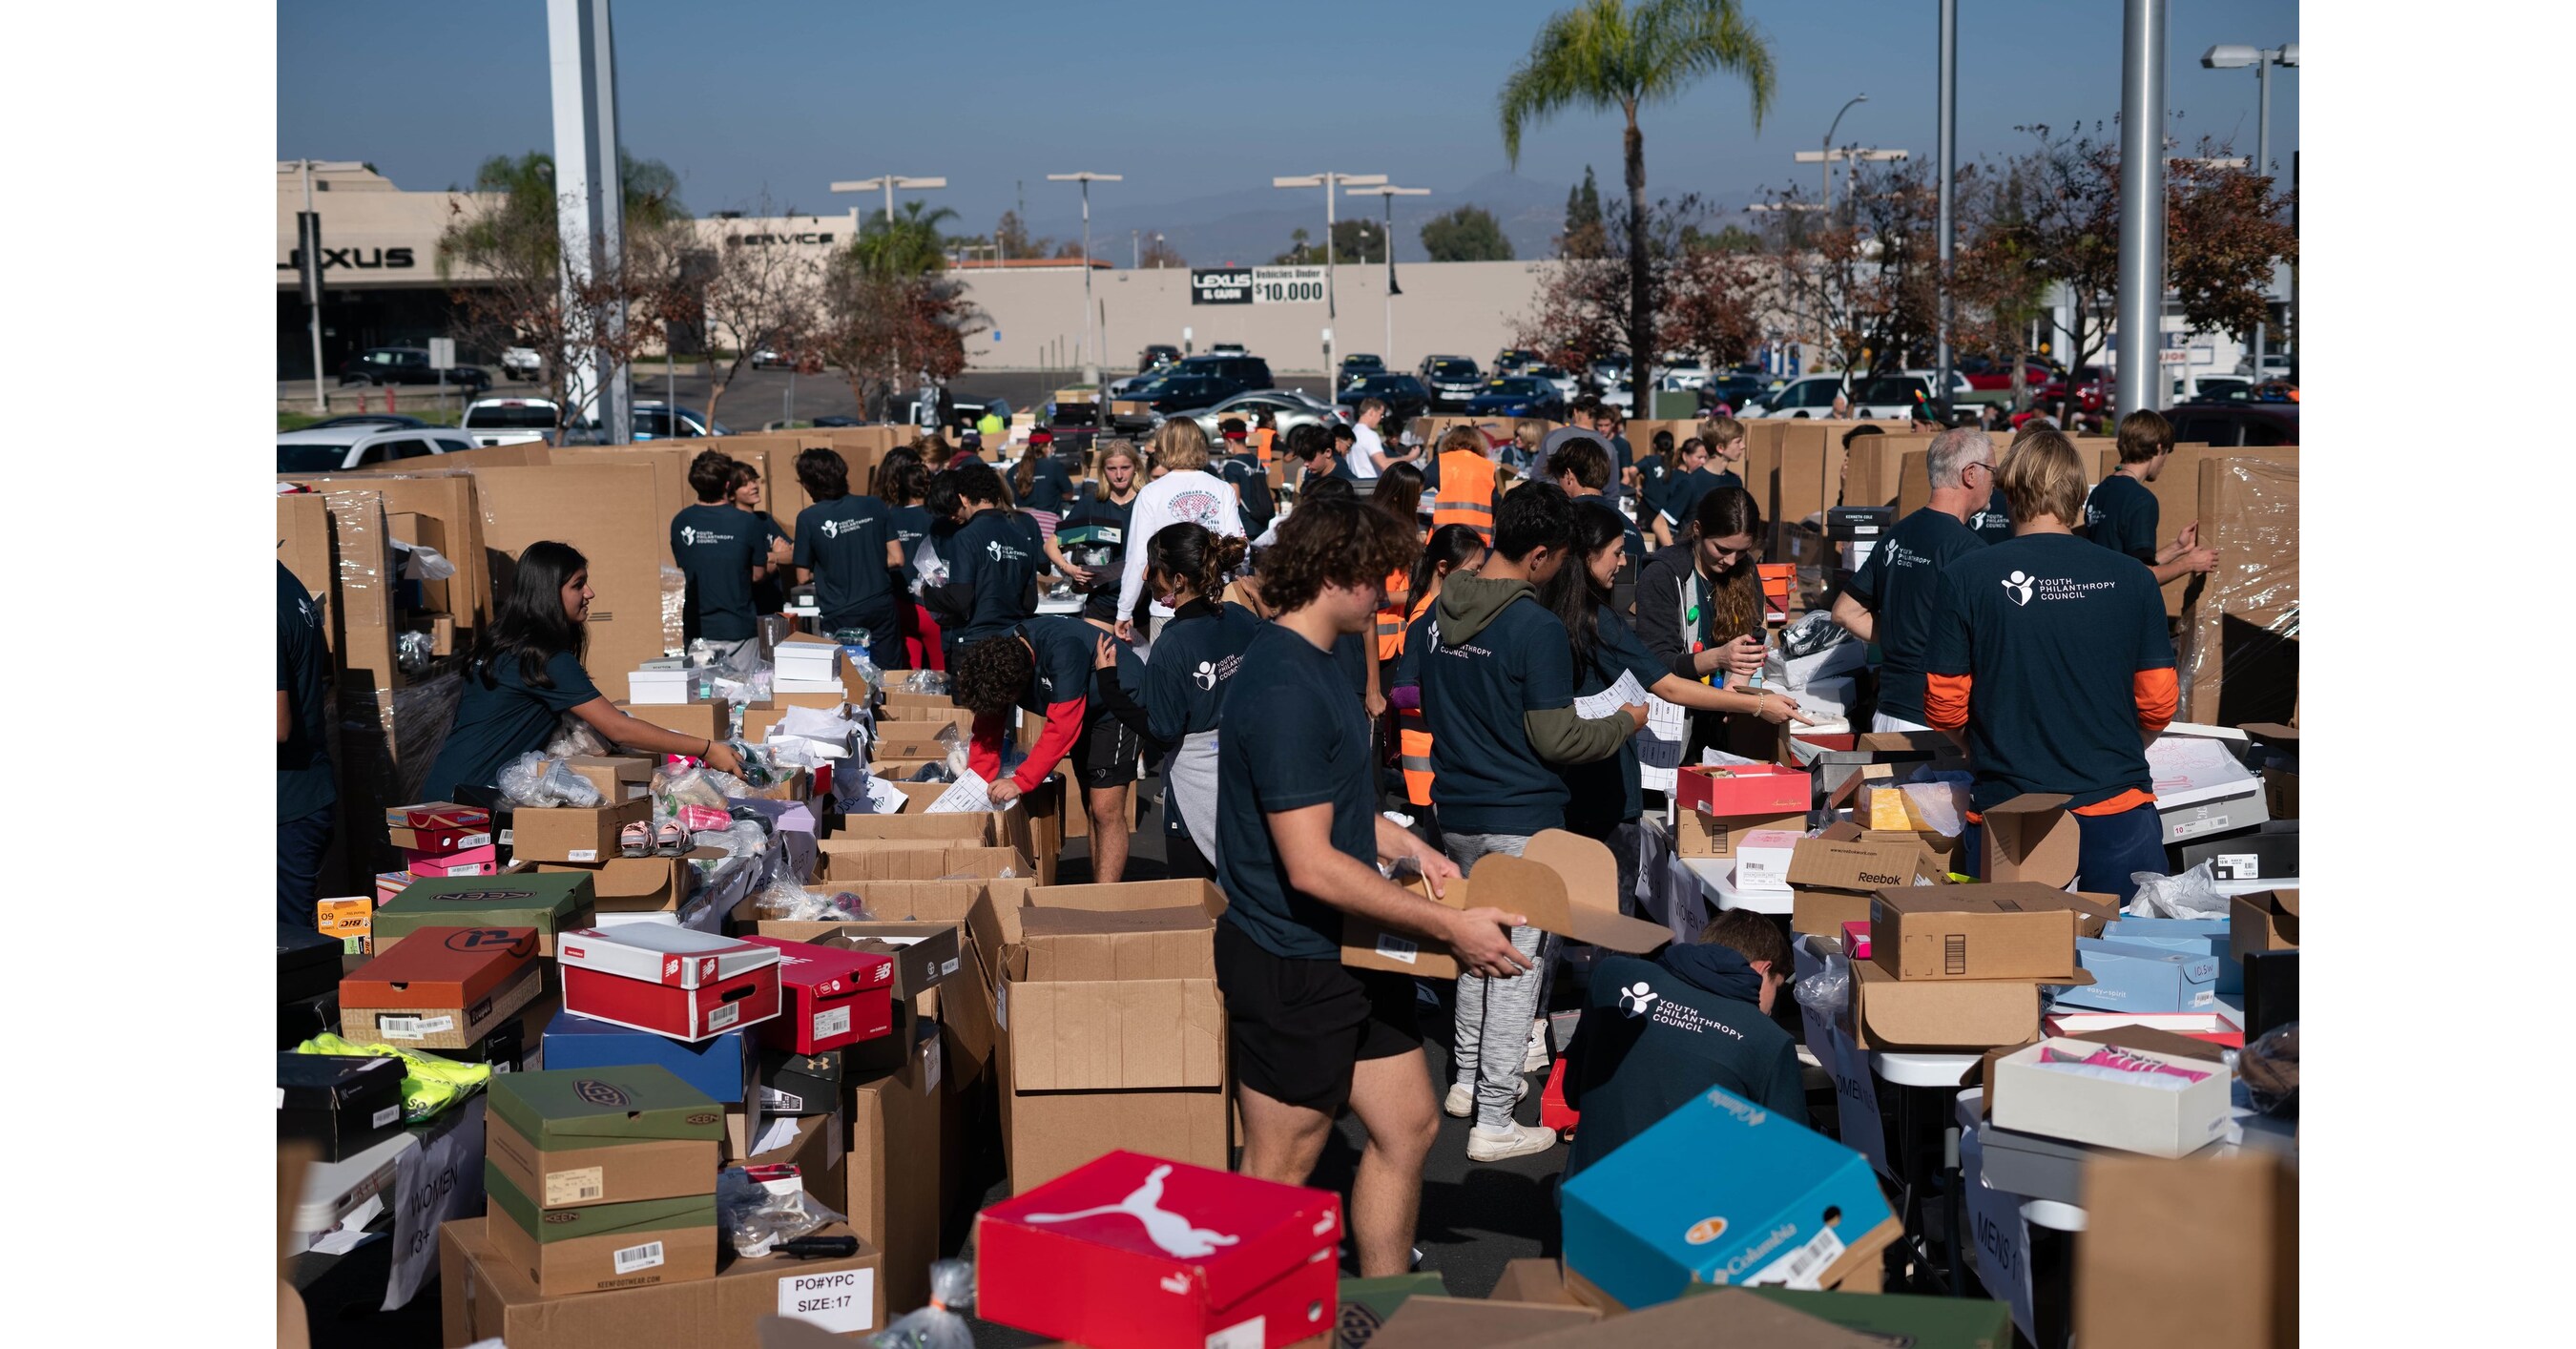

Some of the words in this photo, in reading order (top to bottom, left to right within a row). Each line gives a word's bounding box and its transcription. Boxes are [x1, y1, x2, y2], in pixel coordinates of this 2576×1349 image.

[277, 247, 414, 269] XUS
[1193, 274, 1252, 288] LEXUS
[1255, 282, 1323, 301] $10,000
[2040, 581, 2115, 592] PHILANTHROPY
[2041, 591, 2086, 600] COUNCIL
[1217, 654, 1236, 667] YOUTH
[1859, 872, 1901, 886] Reebok
[1660, 999, 1698, 1016] YOUTH
[1652, 1013, 1703, 1033] COUNCIL
[1655, 1006, 1744, 1040] PHILANTHROPY
[687, 1114, 719, 1124] KEEN
[411, 1163, 458, 1217] WOMEN
[409, 1228, 430, 1257] 13+
[1978, 1211, 2009, 1270] MENS
[1727, 1223, 1797, 1276] Columbia
[597, 1276, 661, 1289] KEENFOOTWEAR.COM
[796, 1274, 854, 1292] PO#YPC
[798, 1296, 852, 1313] SIZE:17
